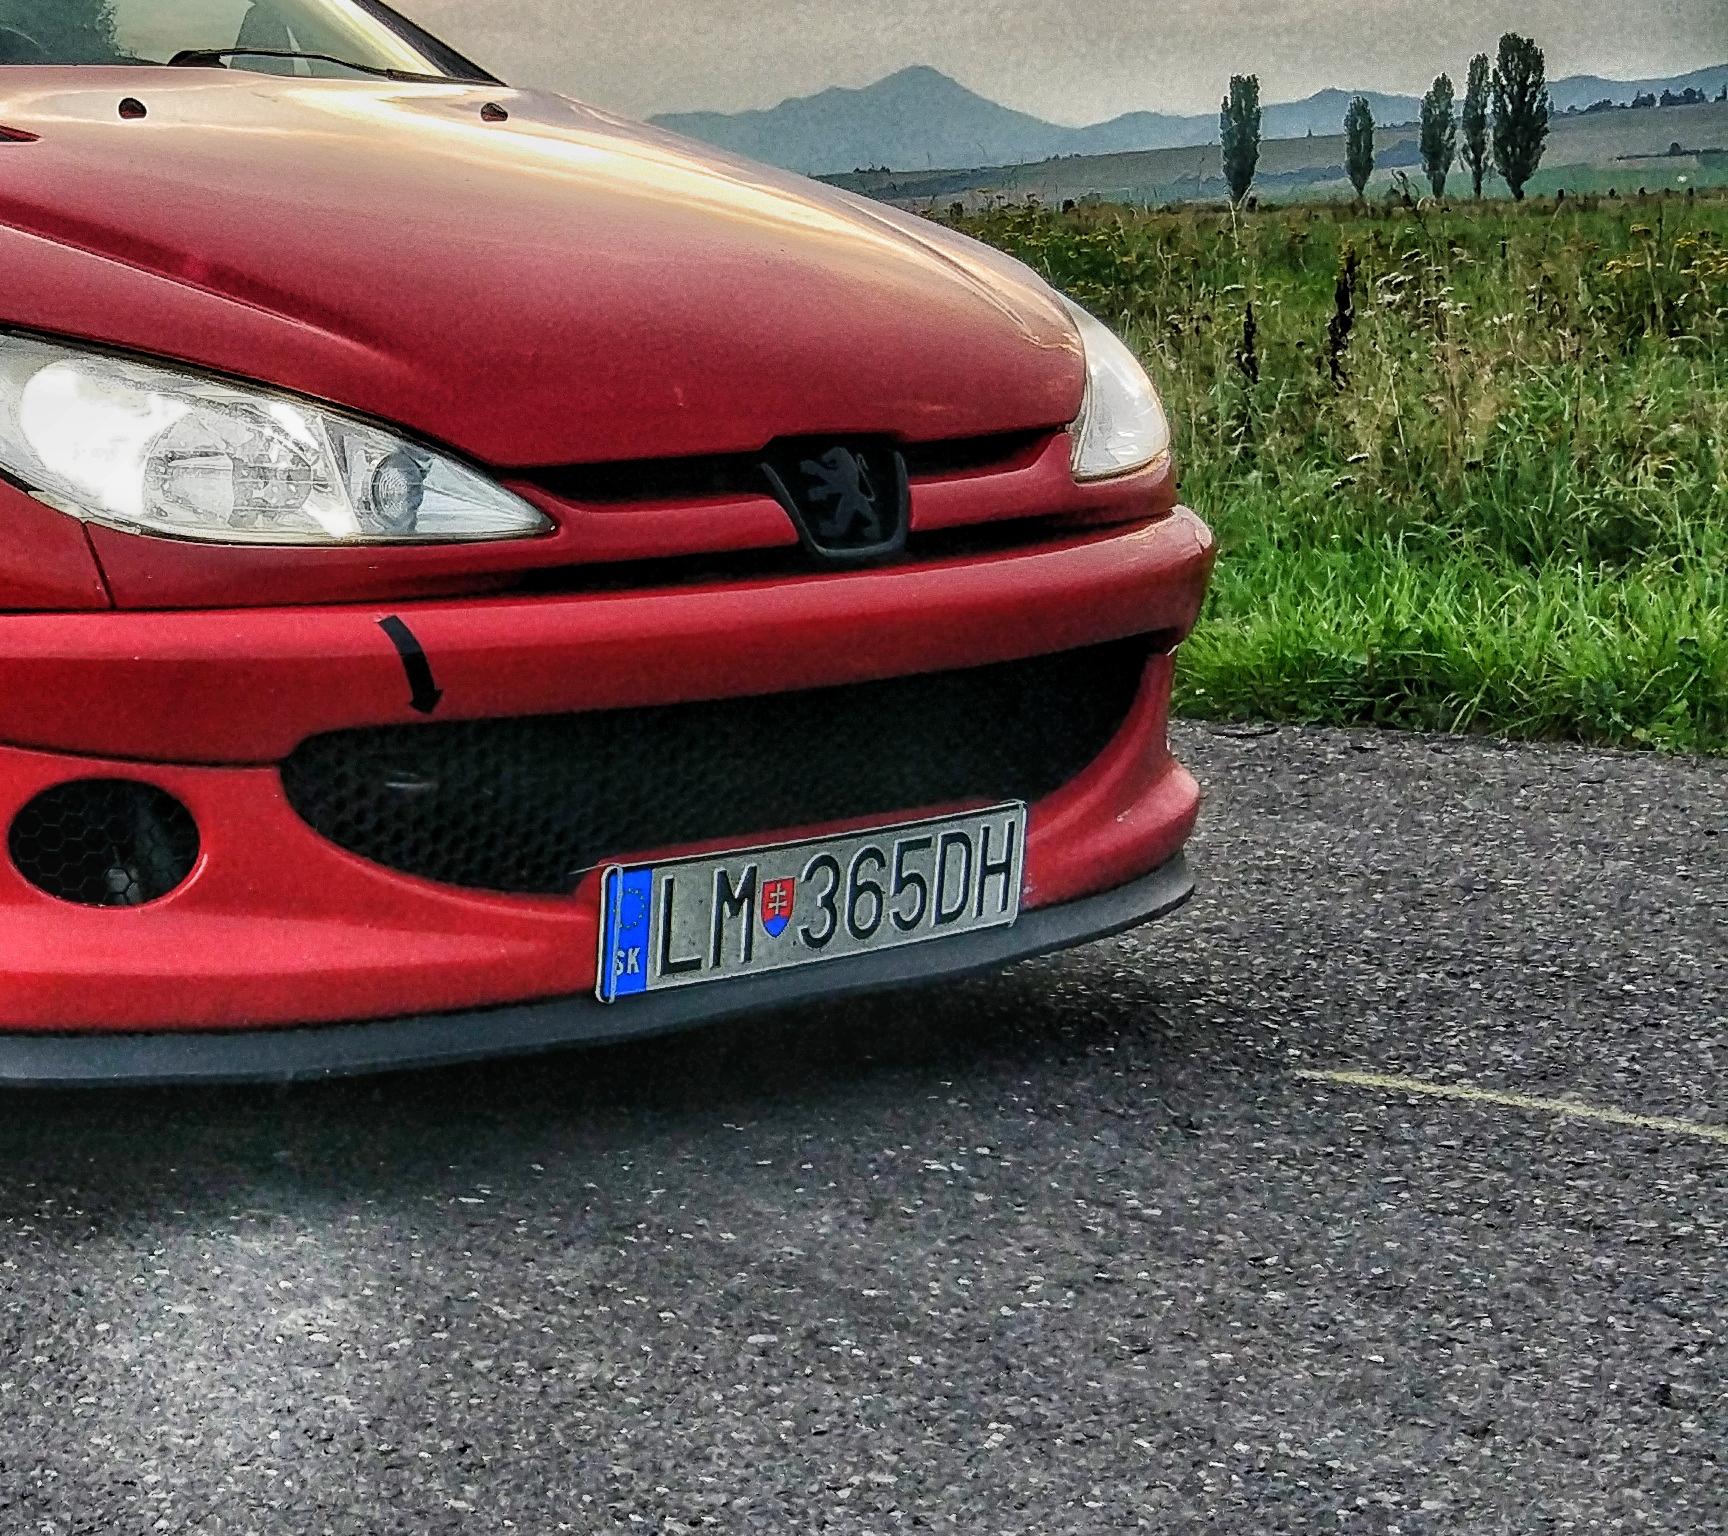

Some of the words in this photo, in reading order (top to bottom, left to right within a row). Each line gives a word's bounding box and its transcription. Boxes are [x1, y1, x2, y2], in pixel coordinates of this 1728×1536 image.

[657, 865, 757, 977] LM
[798, 819, 1016, 951] 365DH
[615, 947, 641, 976] SK
